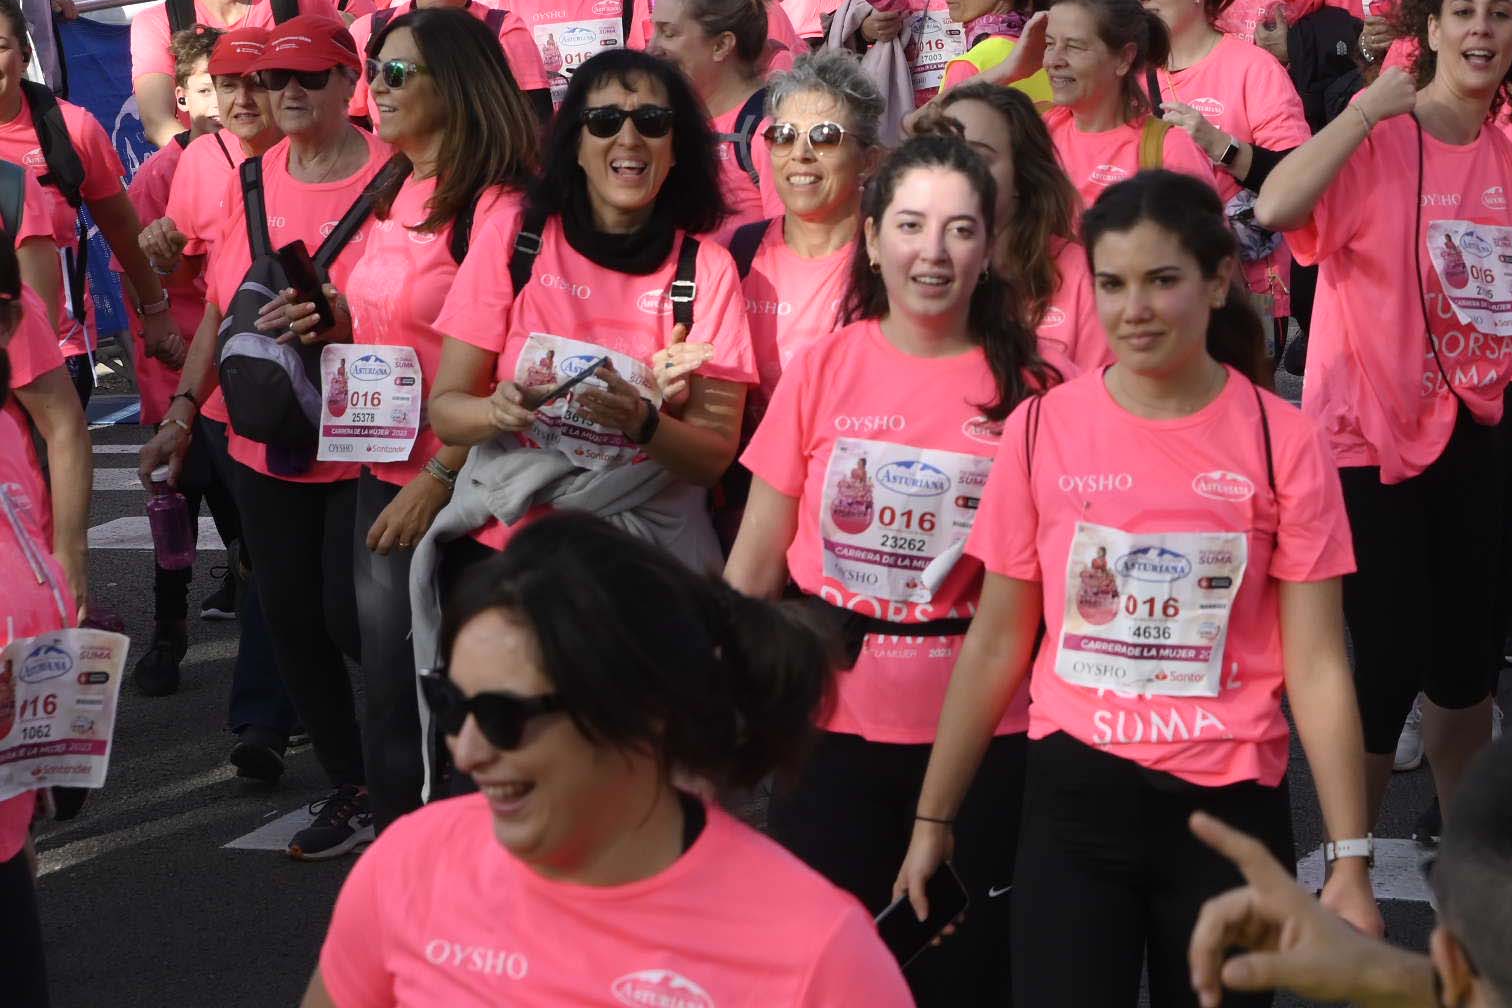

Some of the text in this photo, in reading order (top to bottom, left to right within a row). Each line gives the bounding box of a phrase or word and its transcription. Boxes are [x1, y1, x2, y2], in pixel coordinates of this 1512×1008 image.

[350, 391, 382, 407] 016
[352, 412, 375, 423] 25378
[834, 414, 906, 432] OYSHO
[883, 470, 946, 492] ASTURIANA
[1058, 473, 1133, 492] OYSHO
[878, 505, 937, 533] 016
[880, 534, 926, 553] 23262
[834, 545, 912, 568] CARRERA DE LA
[1198, 555, 1234, 565] SUMA
[1122, 561, 1186, 575] ASTURIANA
[1124, 594, 1181, 618] 016
[1081, 640, 1126, 656] CARRERA
[1143, 646, 1157, 657] LA
[1158, 647, 1197, 660] MUJER
[1073, 661, 1127, 679] OYSHO
[1092, 704, 1227, 746] SUMA
[425, 938, 529, 981] OYSHO
